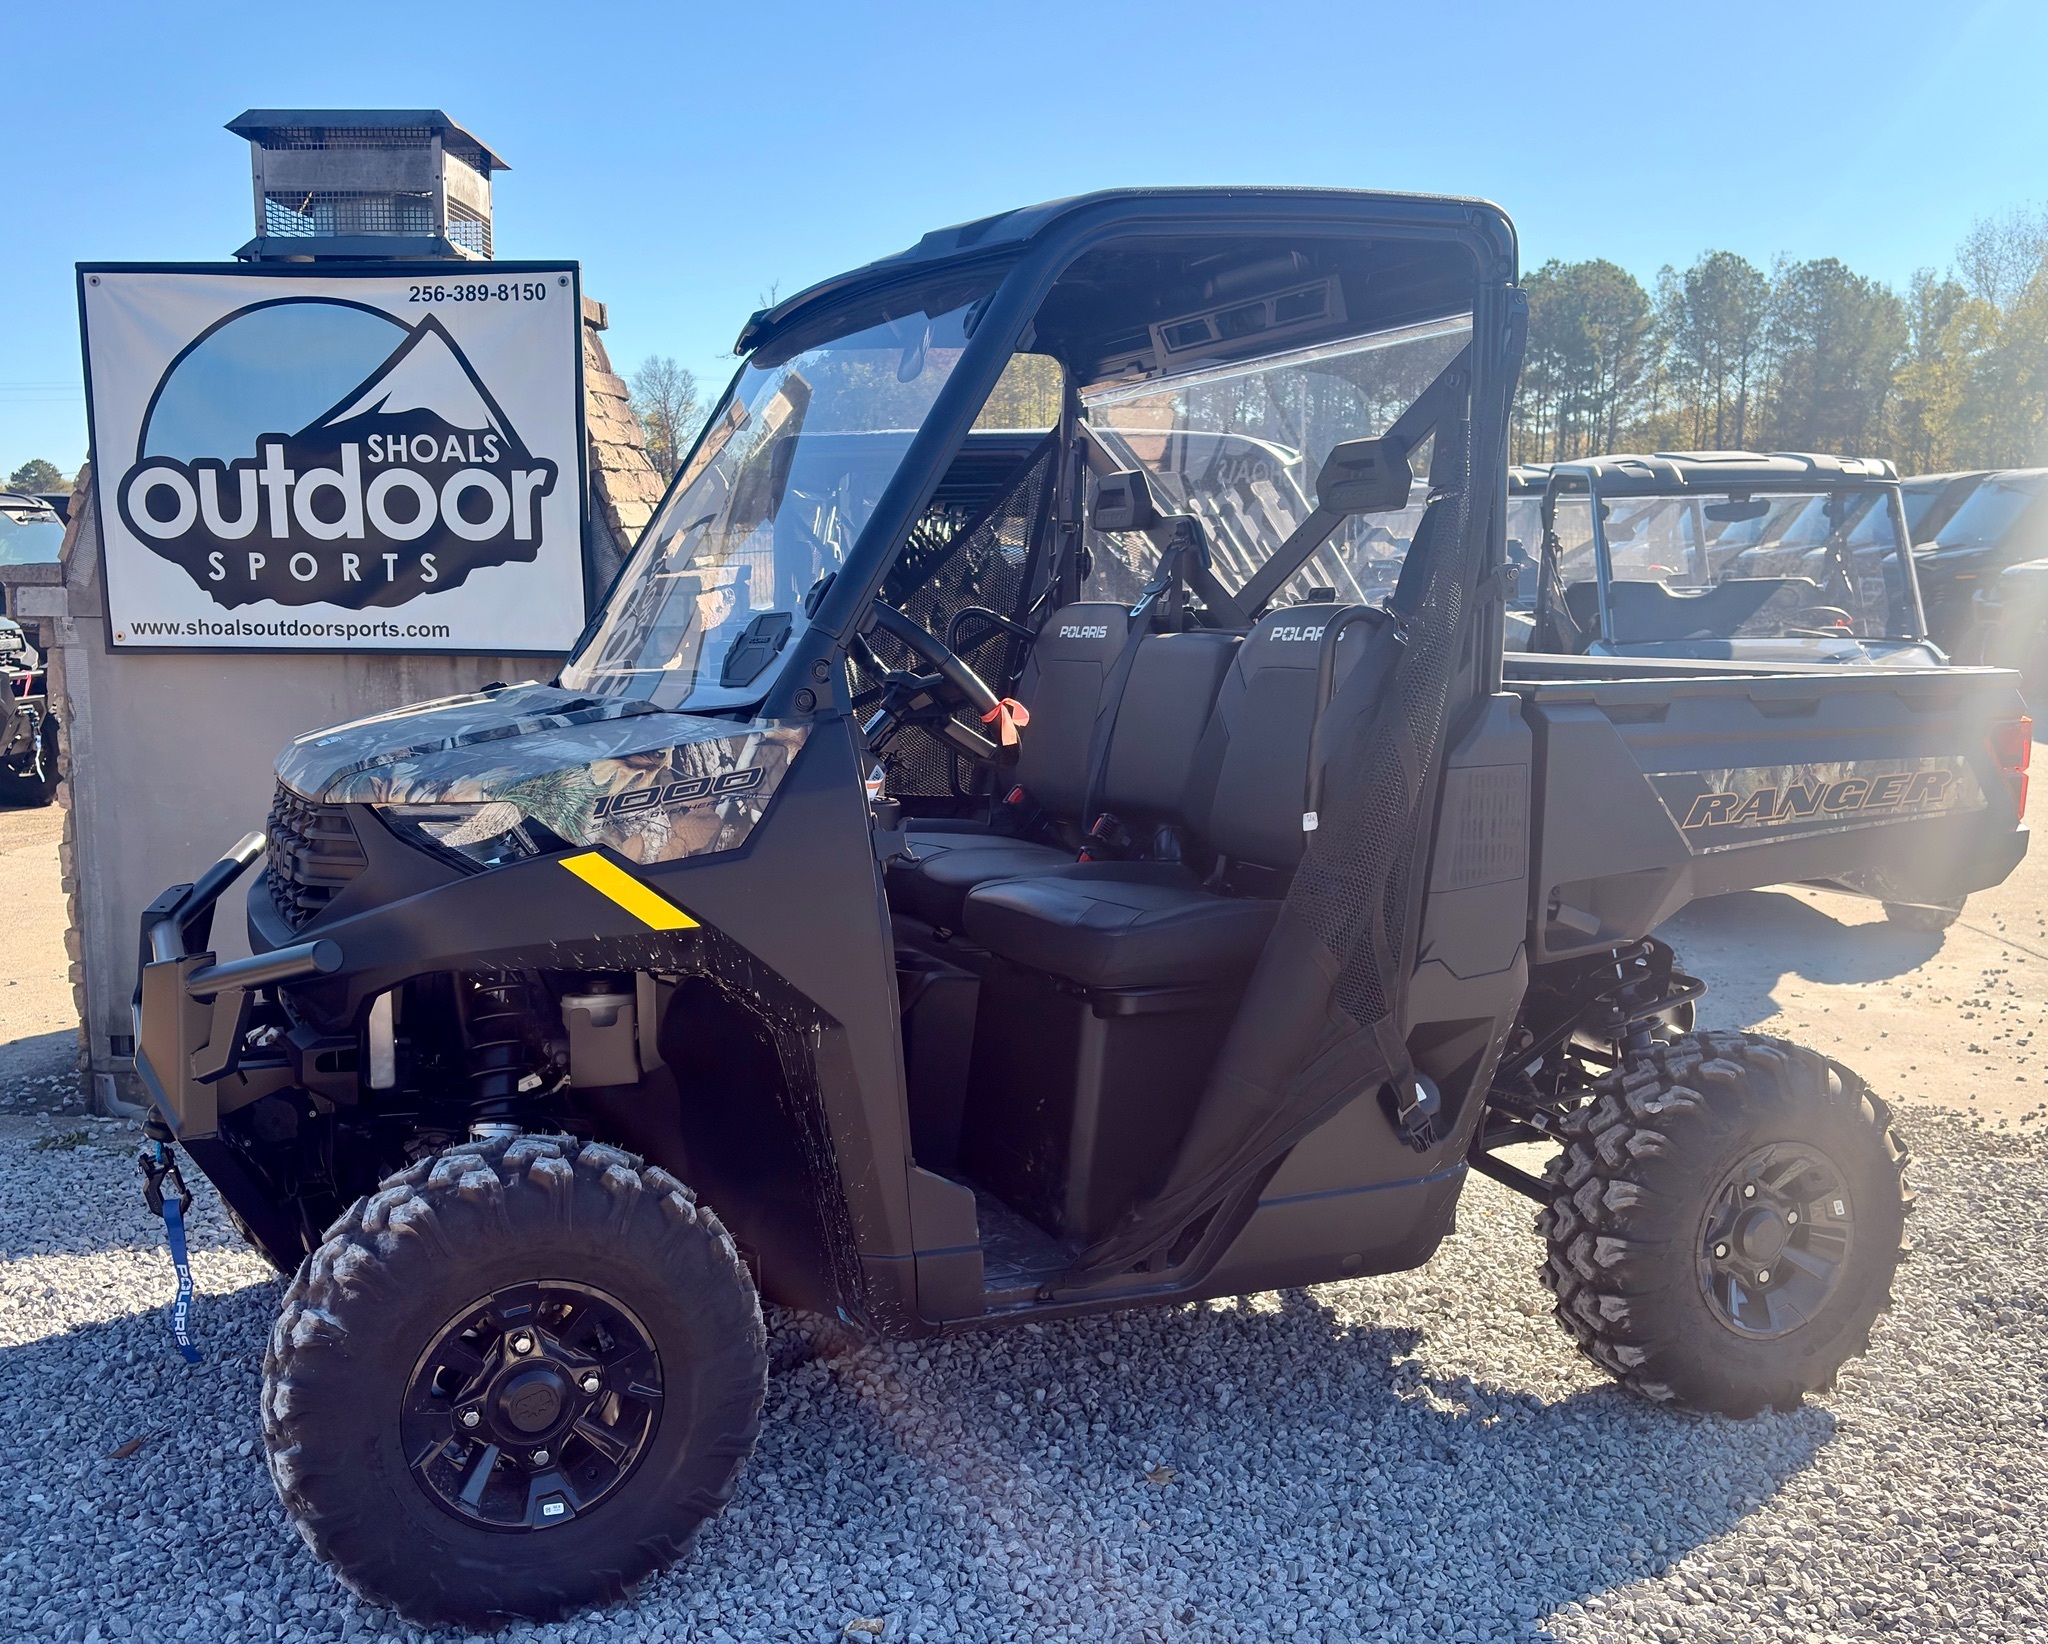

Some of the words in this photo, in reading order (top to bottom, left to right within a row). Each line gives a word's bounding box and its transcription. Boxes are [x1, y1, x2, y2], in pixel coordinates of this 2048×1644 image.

[408, 282, 547, 303] 256-389-8150
[367, 433, 500, 464] SHOALS
[127, 443, 546, 541] outdoor
[208, 551, 438, 582] SPORTS
[131, 619, 450, 641] www.shoalsoutdoorsports.com
[1059, 625, 1107, 639] POLARIS
[1269, 626, 1347, 641] POLARS
[592, 765, 767, 819] 1000
[1681, 769, 1953, 830] RANGER
[174, 1264, 191, 1347] POLARIS
